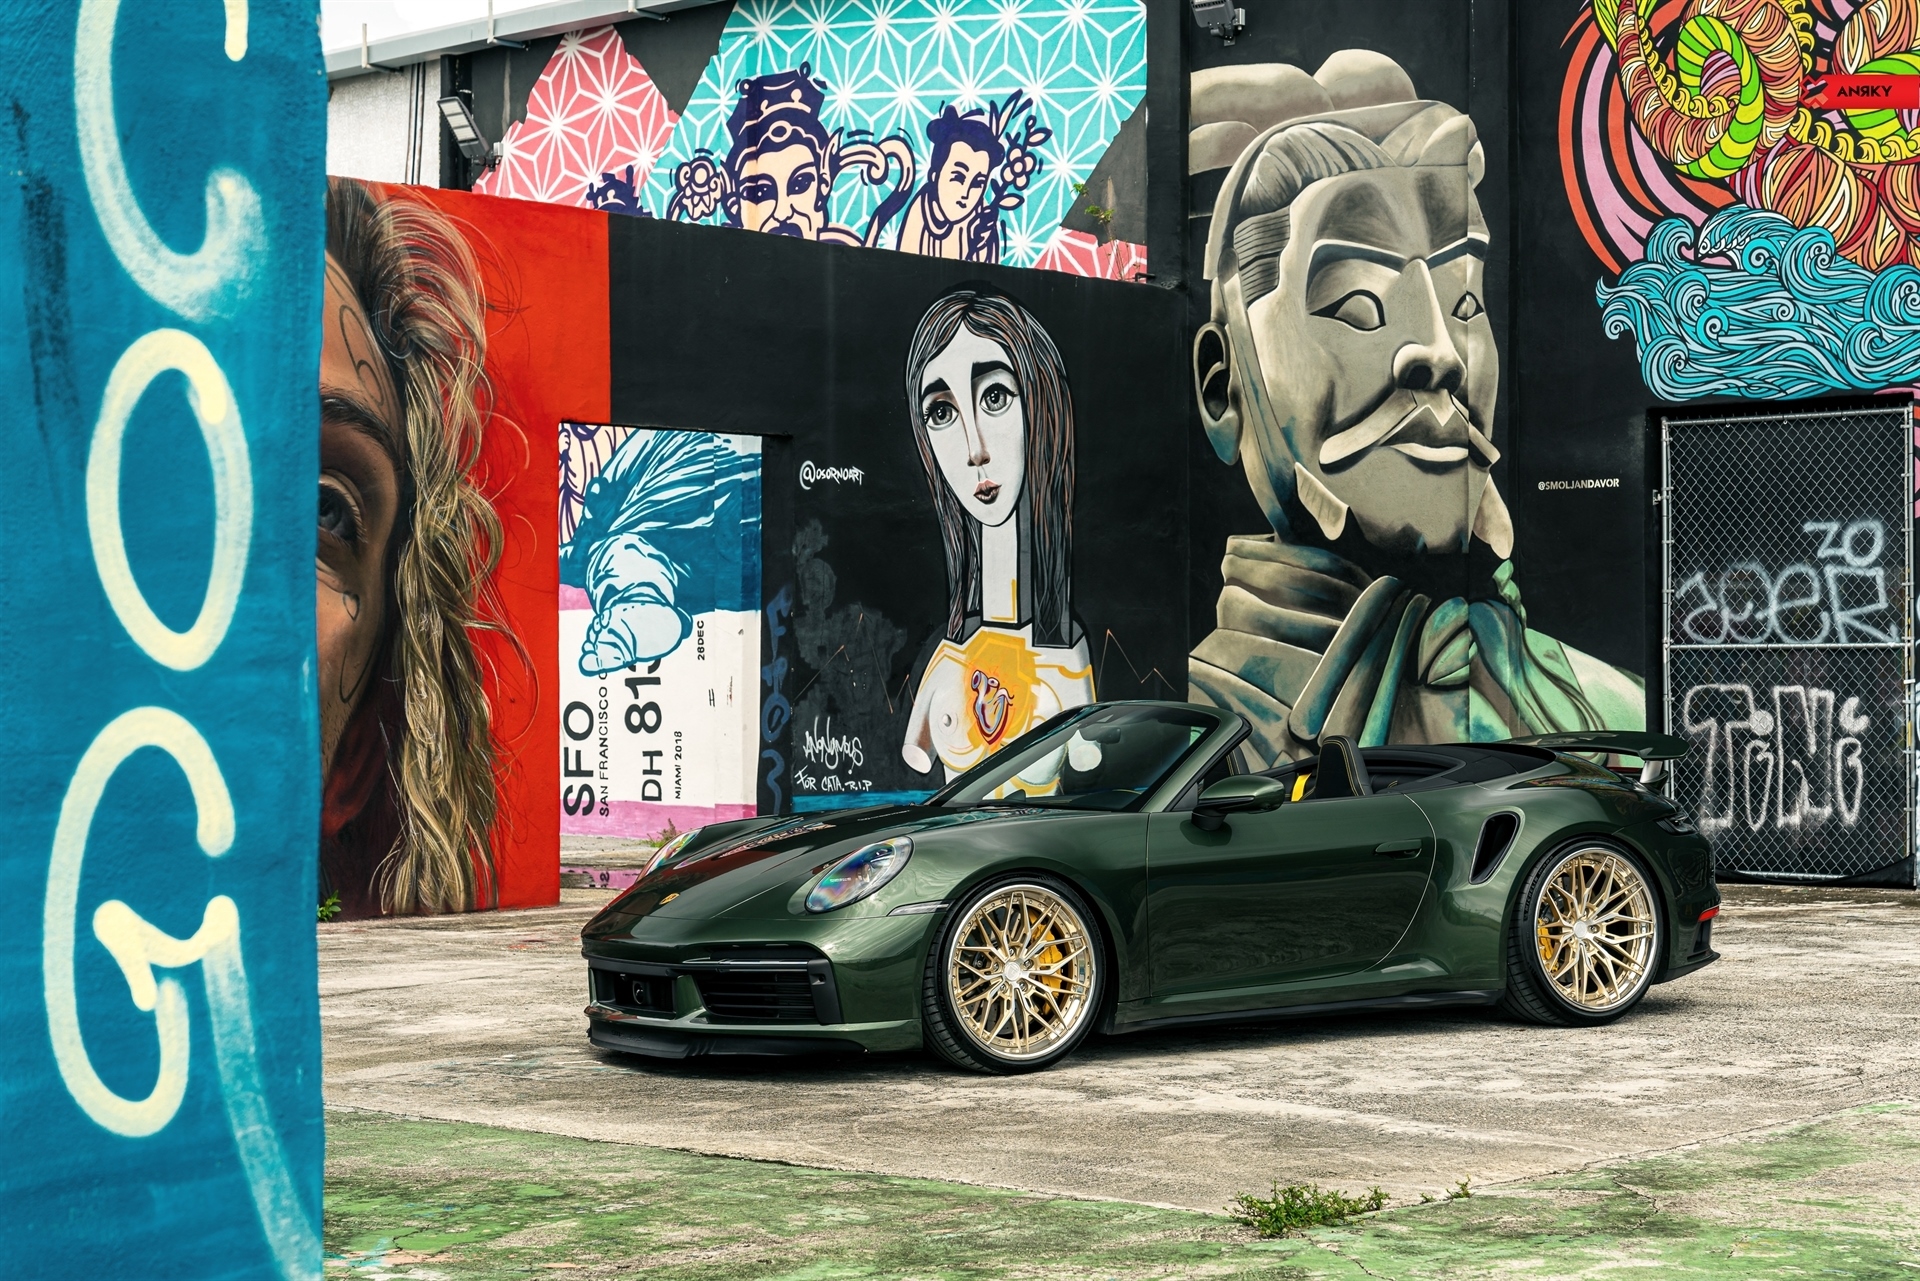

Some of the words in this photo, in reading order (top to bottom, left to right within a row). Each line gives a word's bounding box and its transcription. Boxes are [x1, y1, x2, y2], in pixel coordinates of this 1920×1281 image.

[1538, 478, 1620, 491] @SMOLJANDAVOR
[598, 686, 609, 781] FRANCISCO
[674, 730, 683, 761] 2018
[563, 701, 595, 816] SFO
[641, 750, 663, 801] DH
[599, 785, 609, 817] SAN
